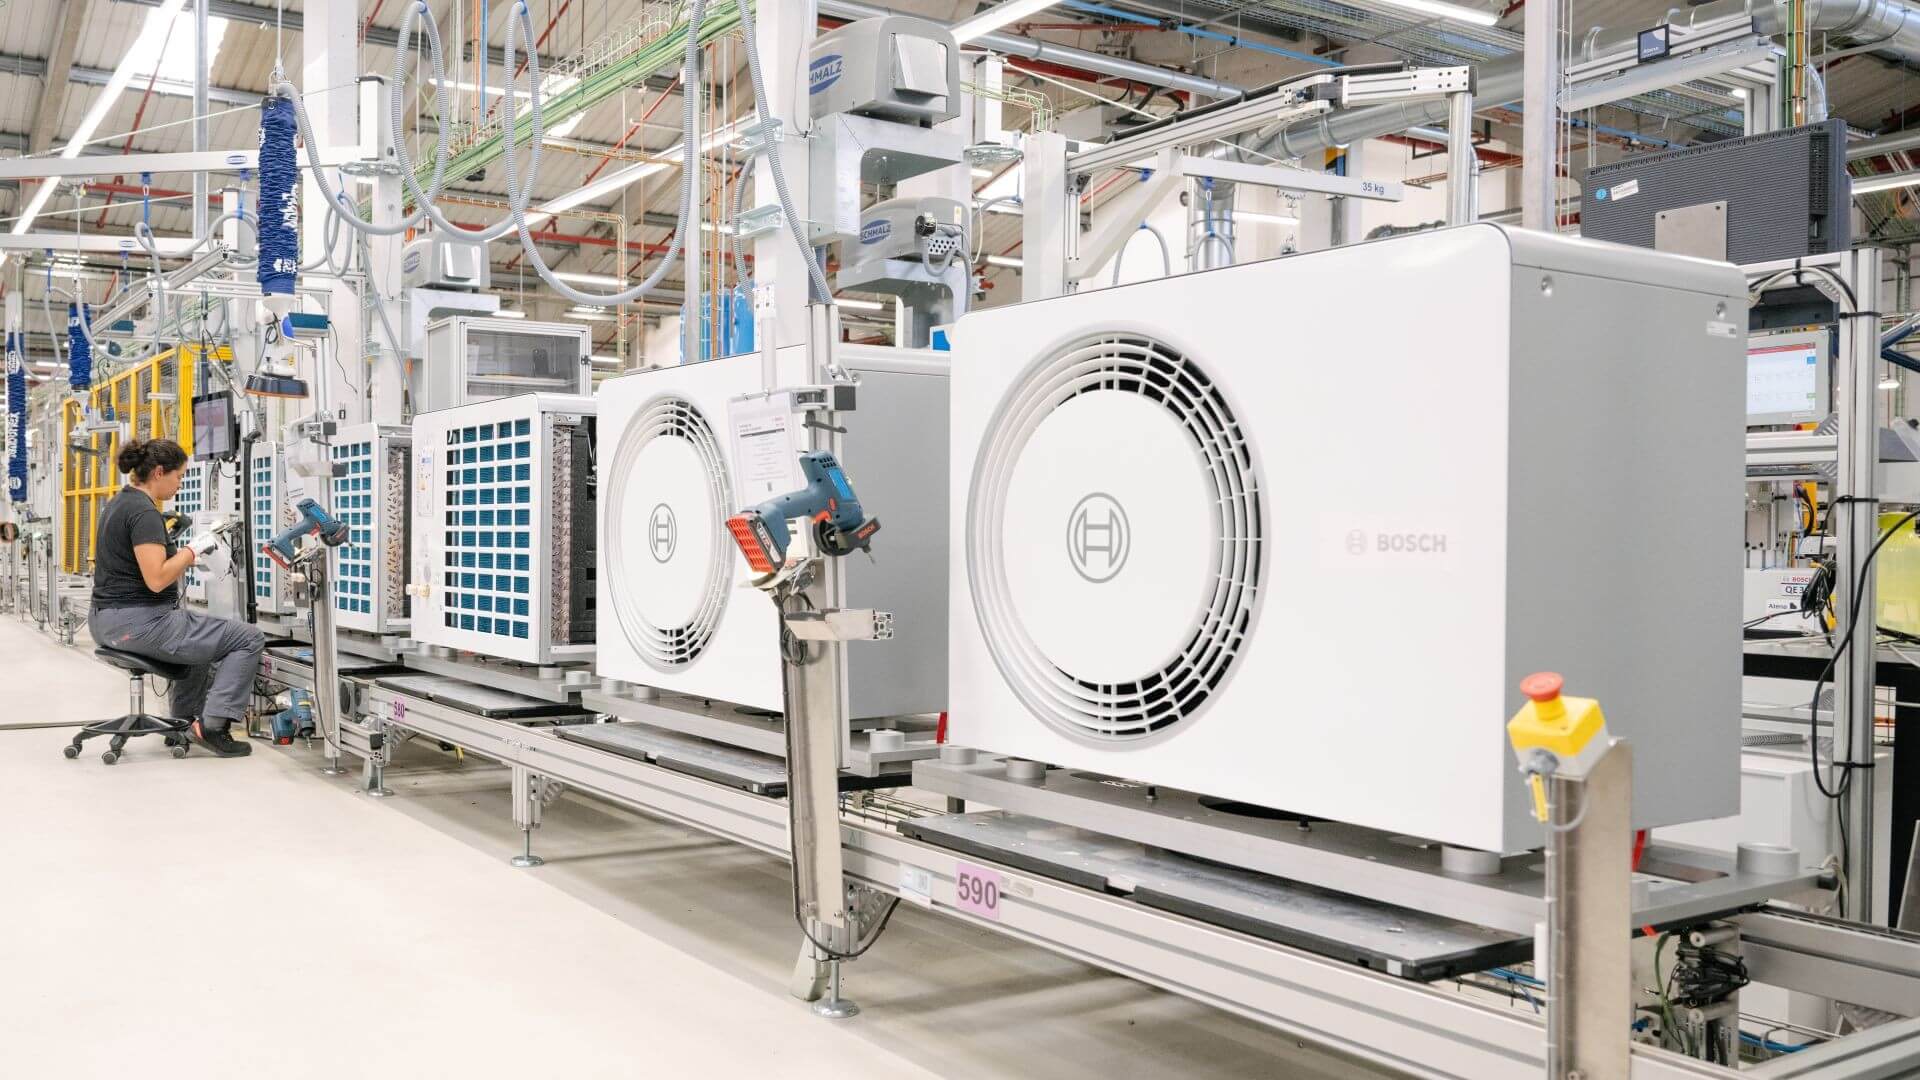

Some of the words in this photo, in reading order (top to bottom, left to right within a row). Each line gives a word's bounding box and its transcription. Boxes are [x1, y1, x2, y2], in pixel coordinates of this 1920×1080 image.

[809, 59, 842, 85] HMALZ
[1362, 182, 1372, 192] 35
[1374, 183, 1385, 196] kg
[1376, 533, 1447, 553] BOSCH
[958, 872, 997, 909] 590
